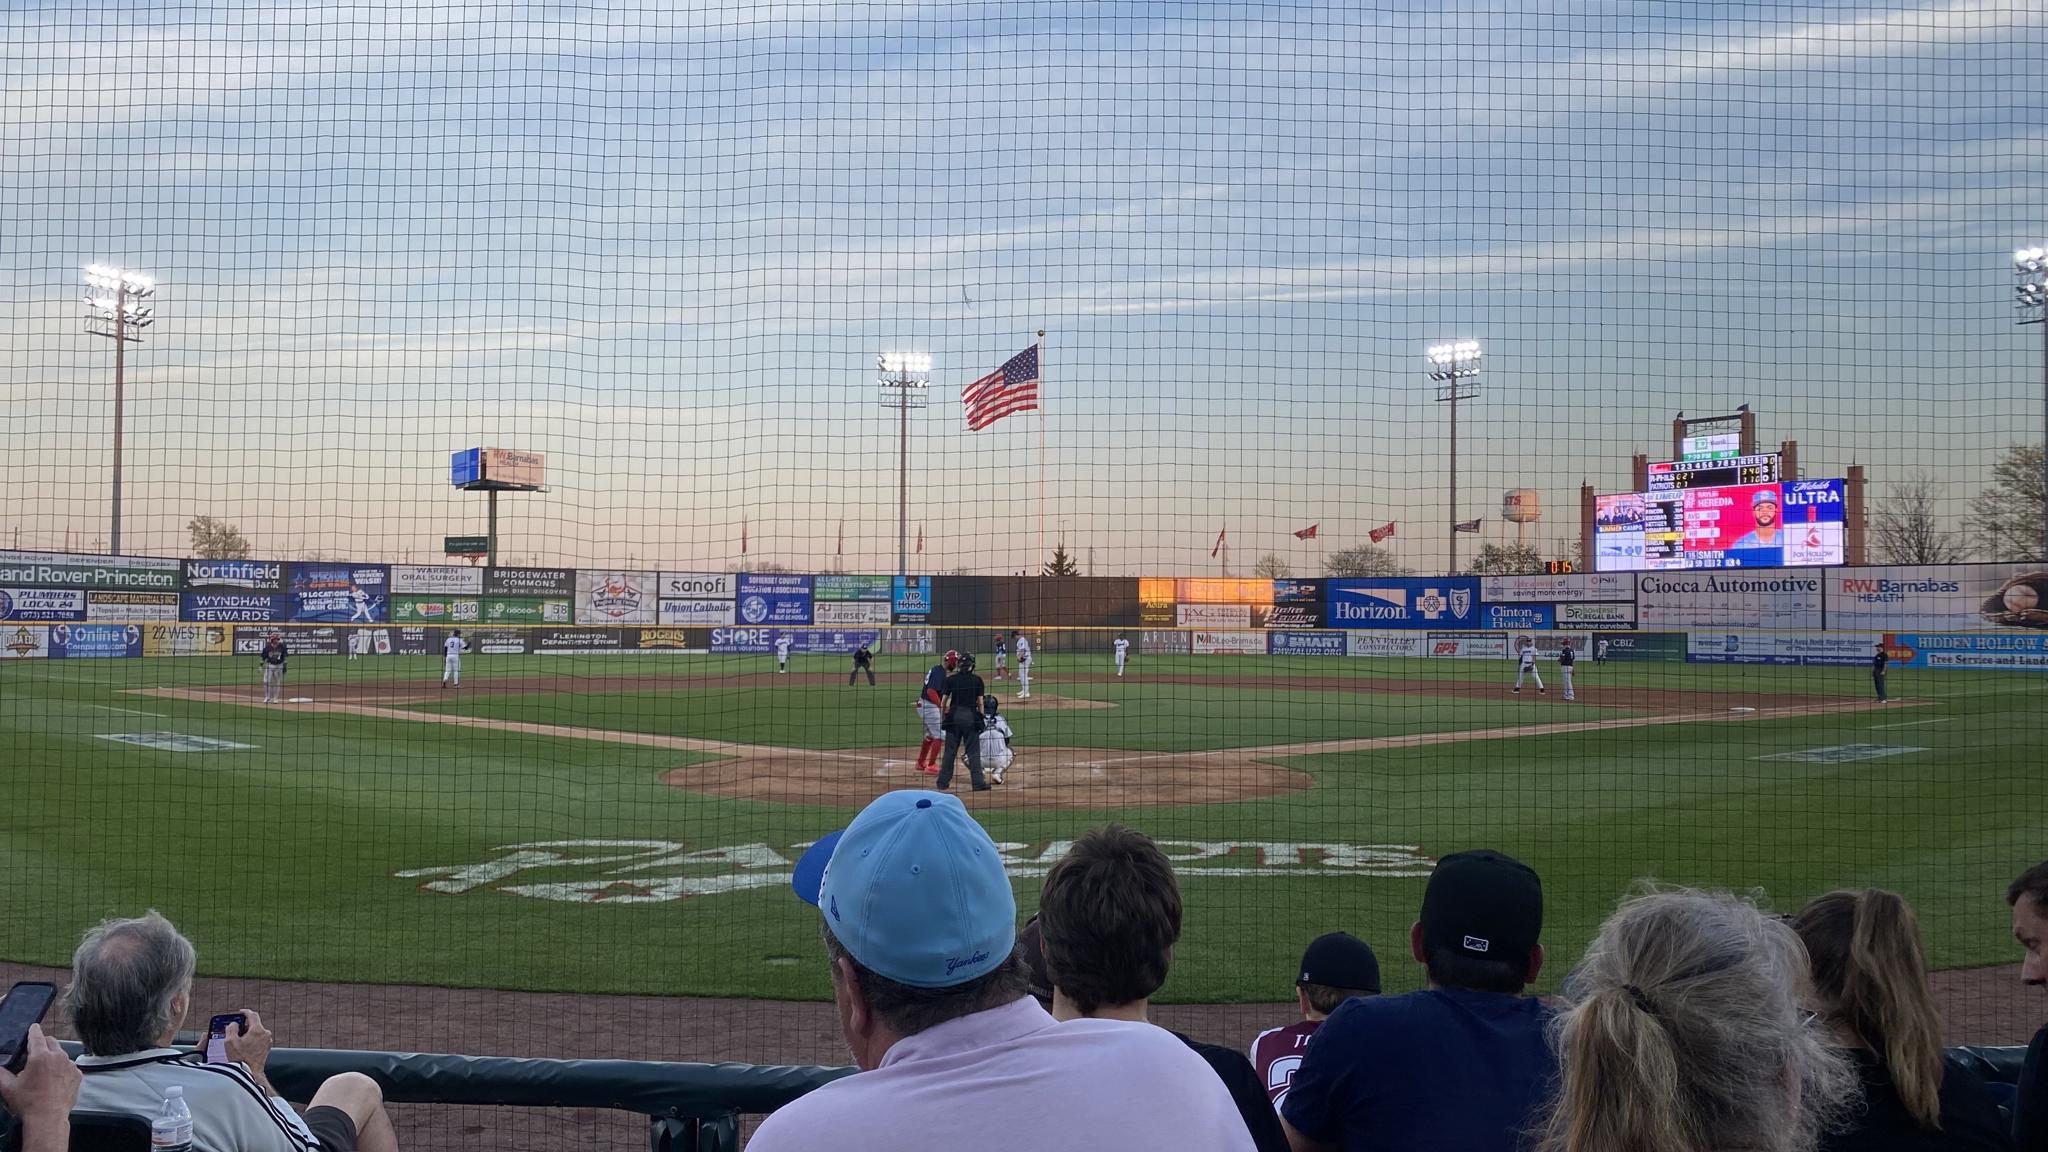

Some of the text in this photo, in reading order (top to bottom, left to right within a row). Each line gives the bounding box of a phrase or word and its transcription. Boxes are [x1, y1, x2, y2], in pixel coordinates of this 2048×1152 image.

[1793, 481, 1830, 491] Michelob
[1656, 491, 1684, 500] LINEUP
[1785, 490, 1840, 505] ULTRA
[1698, 498, 1734, 506] HEREDIA
[1698, 551, 1724, 559] SMITH
[0, 566, 173, 586] and Rover Princeton
[187, 563, 280, 580] Northfield
[494, 571, 566, 579] BRIDGEWATER
[255, 581, 279, 589] Bank
[671, 578, 726, 593] sanofi
[1641, 576, 1700, 594] Ciocca
[1705, 575, 1817, 593] Automotive
[1843, 578, 1959, 593] RWJBarnabas
[19, 591, 77, 599] PLUMBERS
[90, 594, 128, 604] LANDSCAPE
[130, 594, 164, 604] MATERIALS
[905, 592, 920, 600] VIP
[1858, 594, 1904, 603] HEALTH
[196, 596, 270, 606] WYNDHAM
[898, 601, 926, 610] Honda
[446, 604, 477, 614] $ 130
[665, 602, 730, 613] Union Catholic
[1336, 602, 1407, 619] Horizon
[1490, 606, 1532, 617] Clinton
[20, 611, 40, 619] (973)
[197, 611, 270, 621] REWARDS
[1492, 618, 1532, 629] Honda
[75, 628, 120, 642] Online
[153, 626, 200, 640] 22 WEST
[712, 629, 769, 645] SHORE
[1144, 632, 1186, 642] ARLEN
[1196, 634, 1211, 643] NAI
[1290, 637, 1339, 648] SMART
[1918, 637, 2038, 650] HIDDEN HOLLOW
[238, 640, 264, 651] KSI
[1433, 642, 1458, 654] GPS
[1930, 655, 1952, 663] Tree
[1956, 655, 1994, 664] Service
[1995, 656, 2015, 665] and
[946, 950, 990, 976] Yankees
